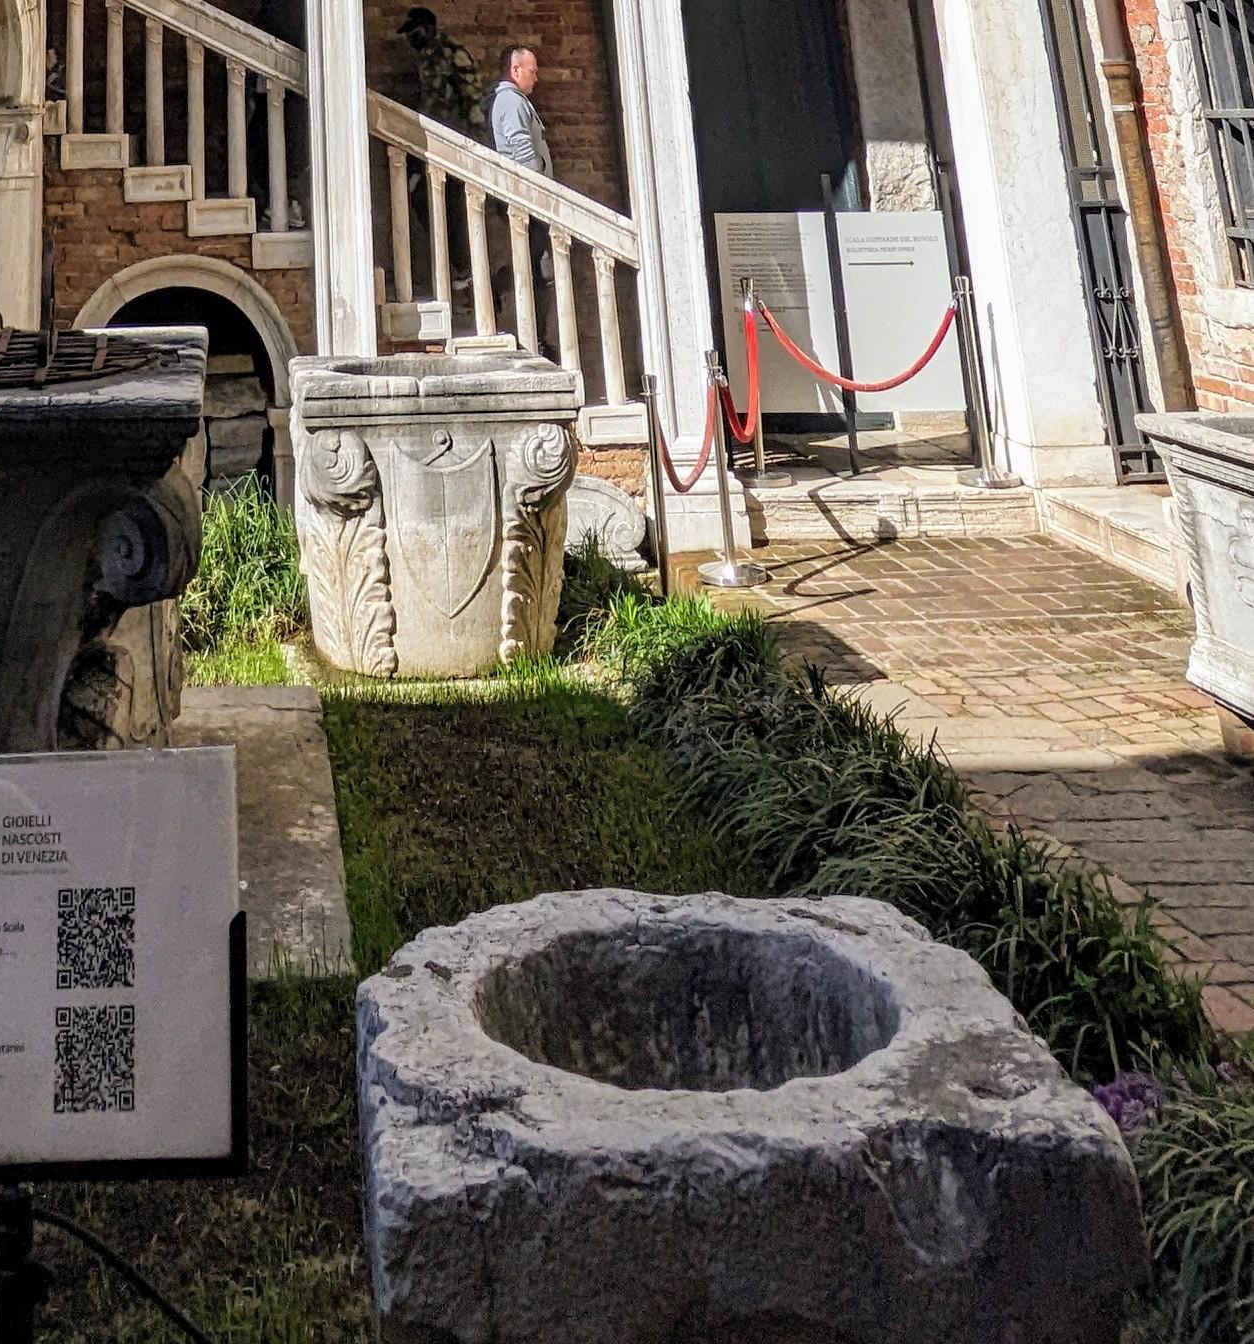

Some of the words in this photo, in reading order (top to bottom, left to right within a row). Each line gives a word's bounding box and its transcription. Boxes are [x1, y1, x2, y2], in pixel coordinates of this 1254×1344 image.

[2, 814, 52, 828] GIOIELLI
[1, 832, 61, 846] NASCOSTI
[1, 851, 14, 864] DI
[16, 850, 68, 864] VENEZIA
[2, 921, 25, 933] Scala
